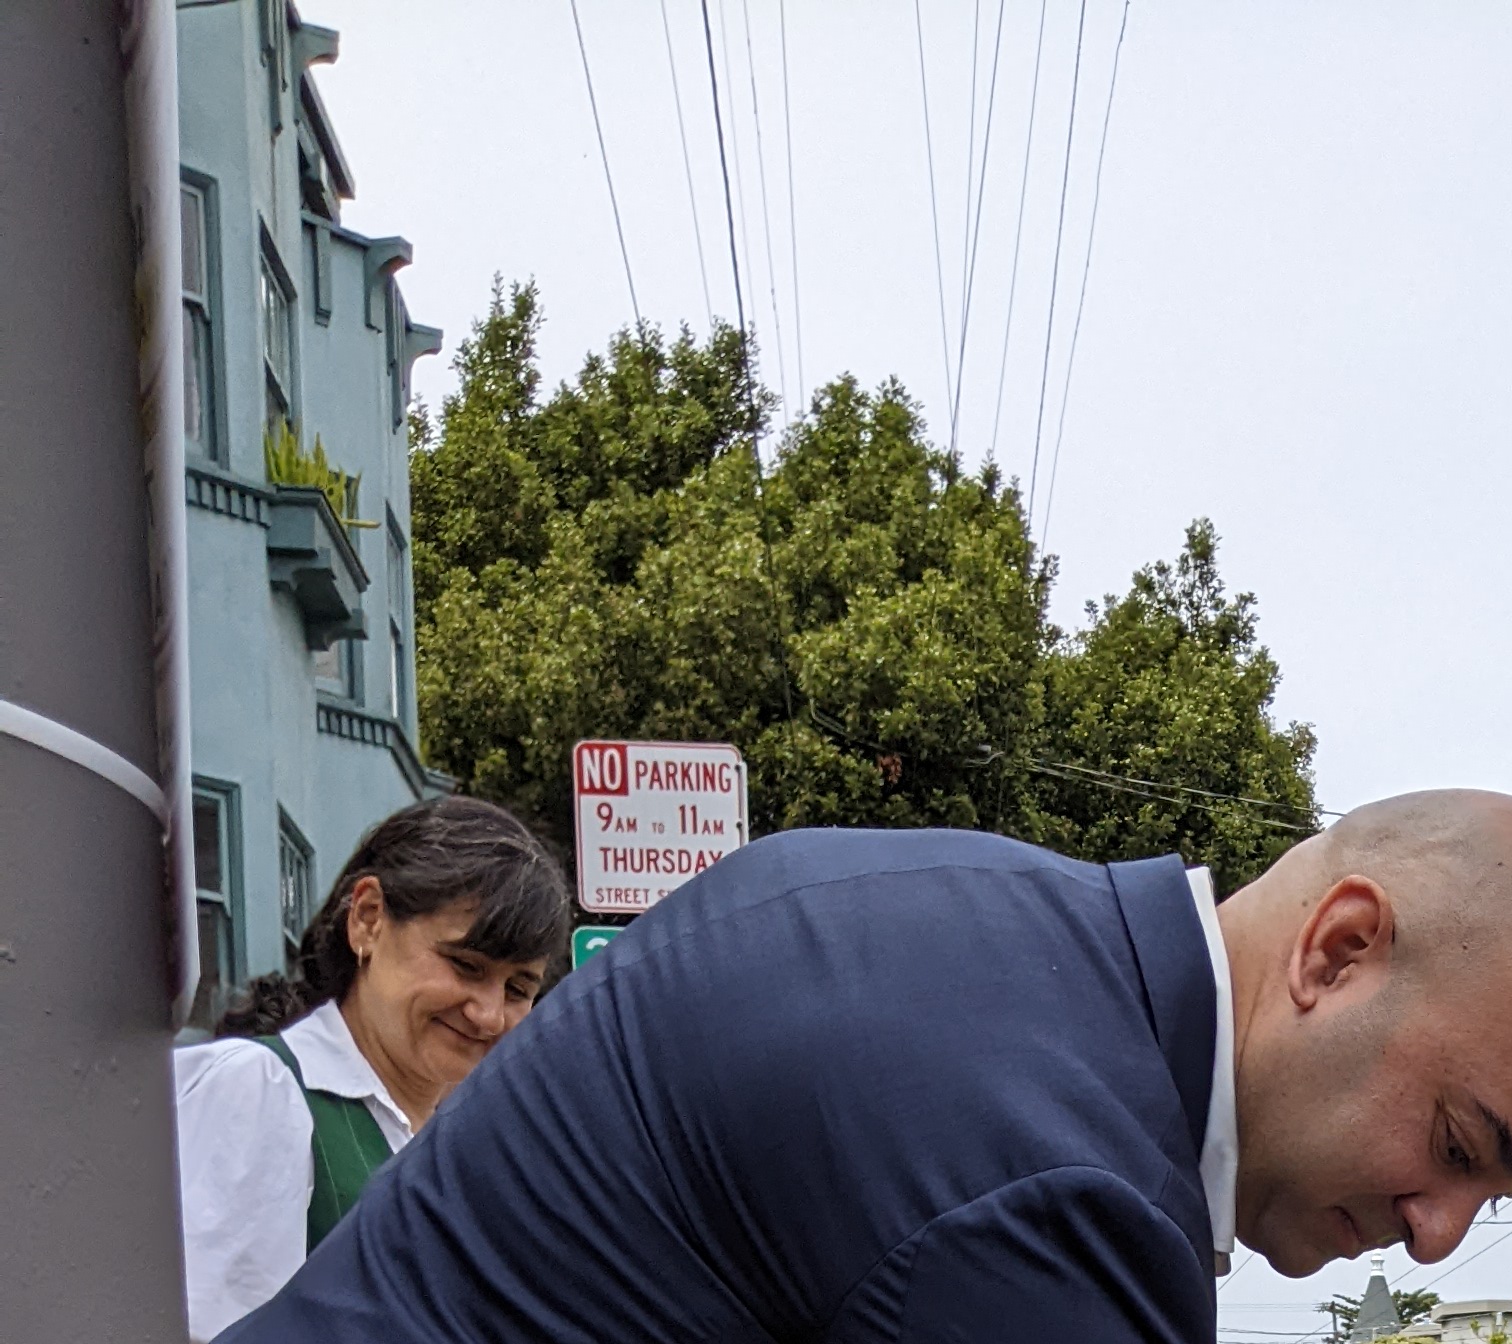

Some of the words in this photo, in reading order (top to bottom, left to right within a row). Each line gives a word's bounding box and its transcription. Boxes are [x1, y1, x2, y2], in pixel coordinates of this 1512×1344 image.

[581, 748, 622, 791] NO
[635, 760, 732, 793] PARKING
[652, 822, 665, 834] TO
[595, 888, 650, 905] STREET
